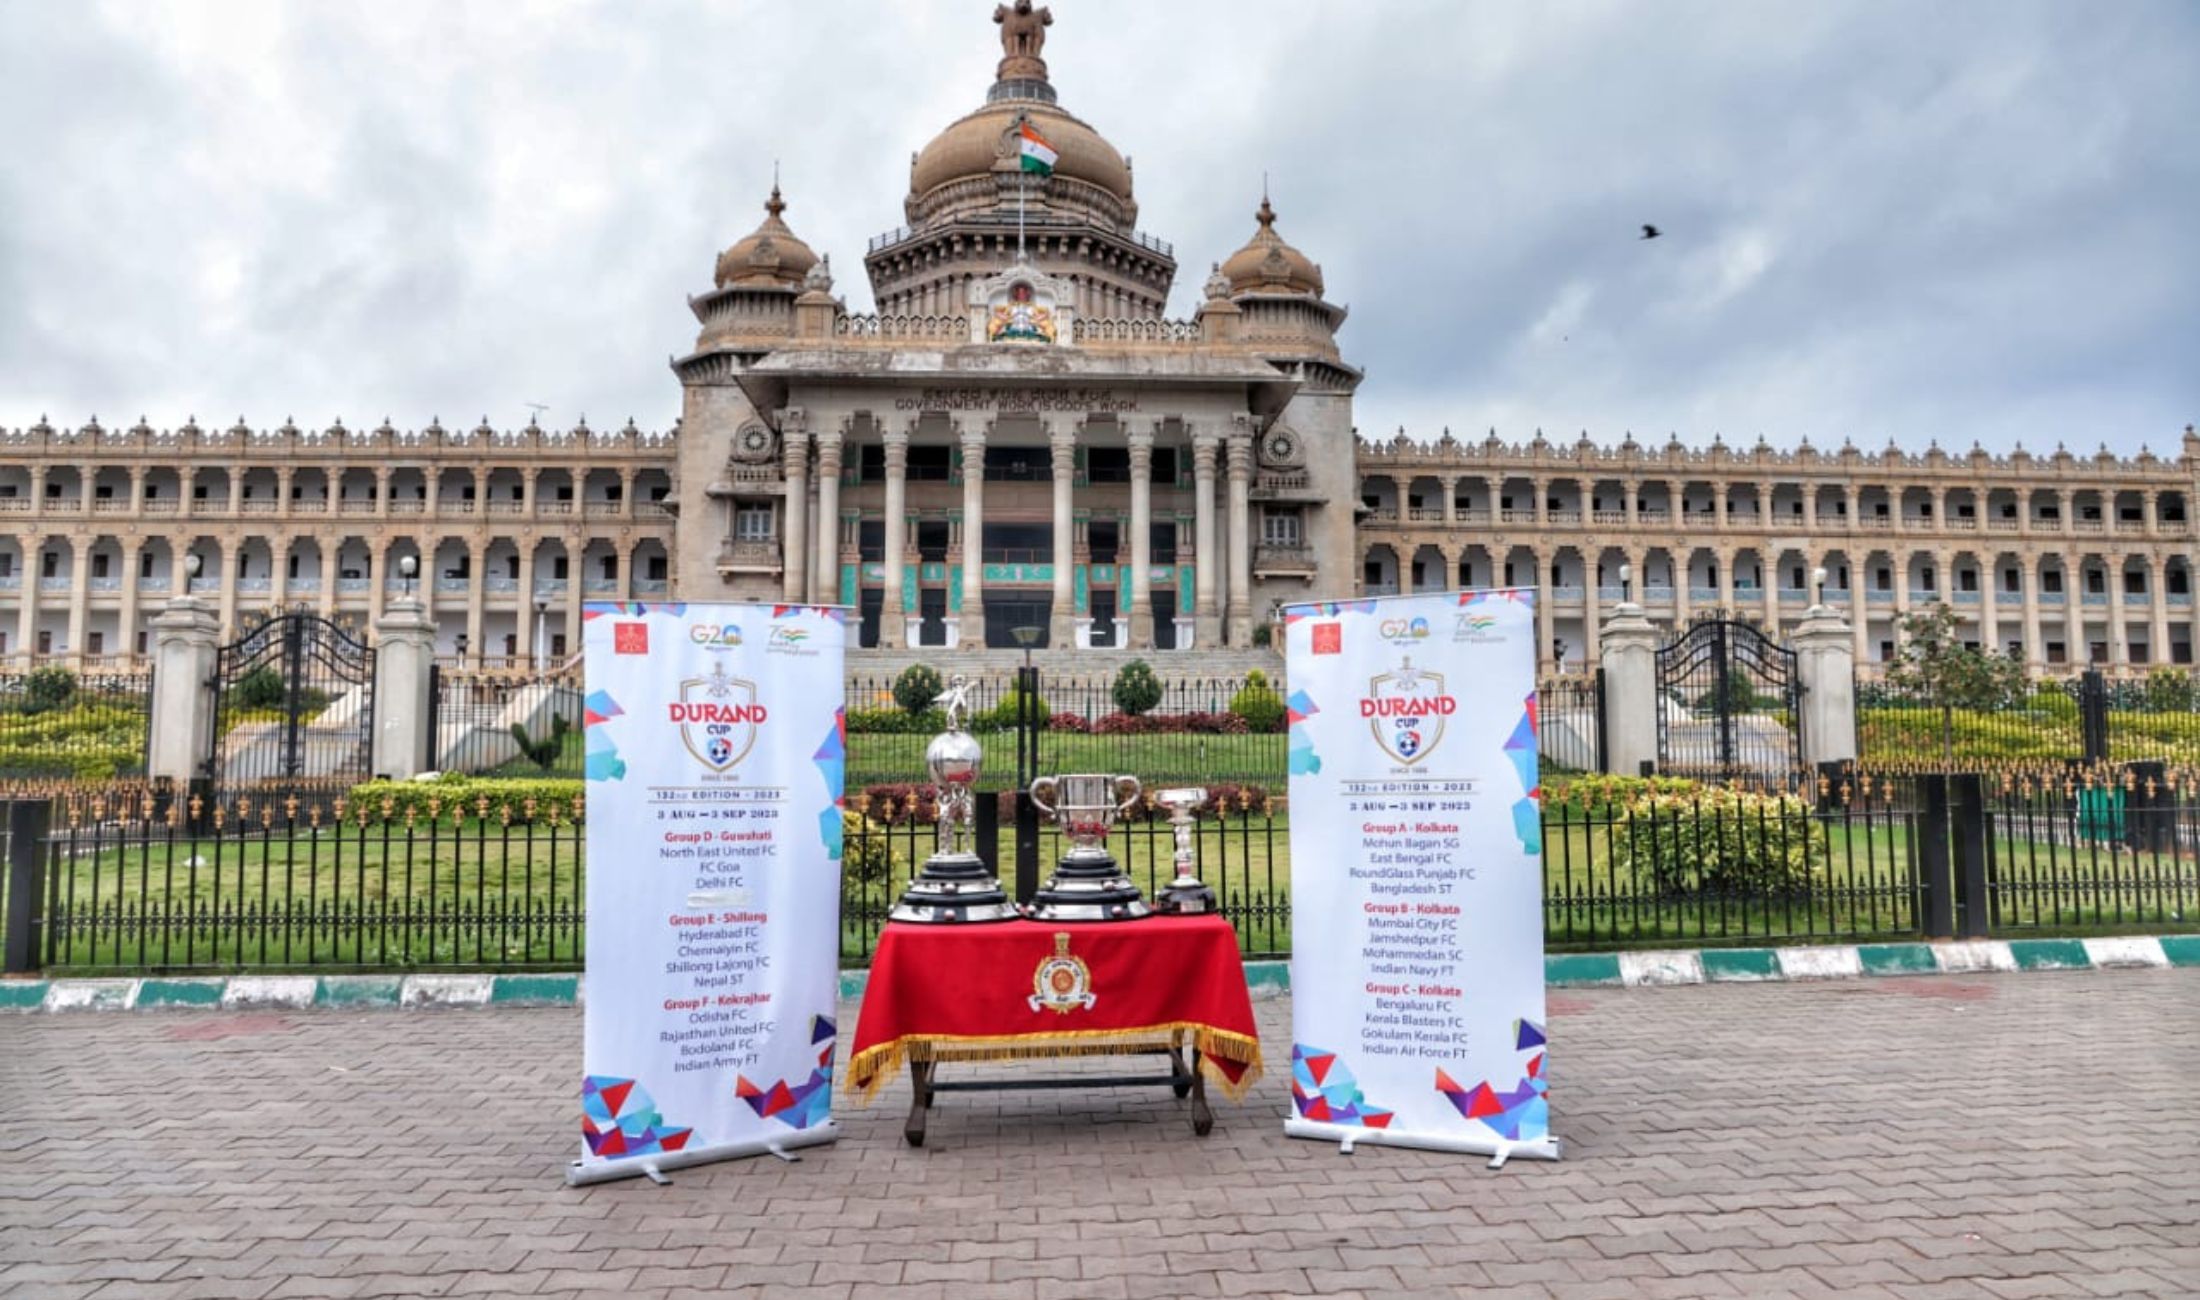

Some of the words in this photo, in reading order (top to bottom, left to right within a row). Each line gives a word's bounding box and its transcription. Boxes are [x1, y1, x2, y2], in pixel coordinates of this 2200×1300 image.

[895, 399, 989, 411] GOVERNMENT
[998, 399, 1033, 411] WORK
[1038, 400, 1051, 411] IS
[690, 624, 743, 646] G20
[1380, 617, 1430, 640] G20
[669, 703, 766, 724] DURAND
[1359, 696, 1456, 718] DURAND
[706, 725, 731, 736] CUP
[1395, 718, 1419, 729] CUP
[1383, 783, 1429, 791] EDITION
[1444, 782, 1472, 791] 2023
[692, 791, 740, 799] EDITION
[754, 790, 780, 799] 2023
[1362, 802, 1386, 811] AUG
[1412, 802, 1436, 811] SEP
[1441, 801, 1471, 811] 2023
[671, 809, 695, 819] AUG
[722, 809, 747, 819] SEP
[751, 809, 778, 819] 2023
[1363, 823, 1396, 835] Group
[1399, 823, 1407, 833] A
[1415, 823, 1458, 833] Kolkata
[664, 832, 701, 844] Group
[703, 831, 712, 841] D
[720, 830, 772, 841] Guwahati
[660, 847, 695, 858] North
[697, 846, 720, 857] East
[722, 845, 760, 857] United
[762, 846, 776, 856] FC
[1363, 838, 1401, 848] Mohun
[1405, 838, 1440, 851] Bagan
[1443, 838, 1460, 848] SG
[1370, 853, 1393, 864] East
[1395, 853, 1434, 866] Bengal
[1437, 853, 1451, 864] FC
[700, 862, 715, 873] FC
[717, 862, 740, 872] Goa
[1350, 867, 1414, 879] RoundGlass
[1417, 868, 1457, 882] Punjab
[1460, 869, 1475, 880] FC
[696, 877, 726, 889] Delhi
[729, 877, 743, 887] FC
[1371, 883, 1436, 896] Bangladesh
[1438, 884, 1453, 894] ST
[1364, 902, 1398, 915] Group
[1400, 904, 1408, 913] B
[1417, 904, 1461, 915] Kolkata
[669, 915, 705, 927] Group
[708, 914, 715, 924] E
[723, 912, 768, 924] Shillong
[1368, 918, 1414, 929] Mumbai
[1416, 918, 1439, 931] City
[1442, 919, 1457, 930] FC
[678, 928, 743, 942] Hyderabad
[744, 927, 759, 937] FC
[1369, 933, 1439, 947] Jamshedpur
[1441, 935, 1457, 946] FC
[677, 944, 743, 958] Chennaiyin
[745, 942, 759, 953] FC
[1363, 948, 1446, 961] Mohammedan
[1448, 950, 1463, 961] SC
[666, 961, 713, 974] Shillong
[716, 958, 754, 972] Lajong
[755, 957, 770, 967] FC
[1371, 963, 1407, 974] Indian
[1409, 964, 1438, 978] Navy
[1441, 965, 1455, 976] FT
[694, 975, 728, 988] Nepal
[730, 974, 744, 985] ST
[1366, 982, 1400, 996] Group
[1402, 984, 1410, 995] C
[1419, 985, 1462, 997] Kolkata
[664, 998, 700, 1011] Group
[702, 996, 709, 1006] F
[718, 993, 771, 1006] Kokrajhar
[1376, 998, 1434, 1012] Bengaluru
[1436, 1001, 1452, 1012] FC
[689, 1011, 729, 1024] Odisha
[732, 1010, 747, 1020] FC
[1366, 1013, 1400, 1025] Kerala
[1402, 1015, 1446, 1027] Blasters
[1449, 1017, 1464, 1028] FC
[660, 1029, 716, 1043] Rajasthan
[719, 1024, 757, 1036] United
[759, 1022, 776, 1032] FC
[1361, 1028, 1412, 1041] Gokulam
[1414, 1031, 1450, 1043] Kerala
[1452, 1033, 1468, 1044] FC
[681, 1042, 735, 1055] Bodoland
[738, 1040, 753, 1050] FC
[1363, 1043, 1399, 1055] Indian
[1400, 1045, 1416, 1056] Air
[1419, 1047, 1450, 1059] Force
[1453, 1048, 1468, 1059] FT
[674, 1059, 710, 1072] Indian
[712, 1057, 742, 1069] Army
[745, 1054, 759, 1065] FT
